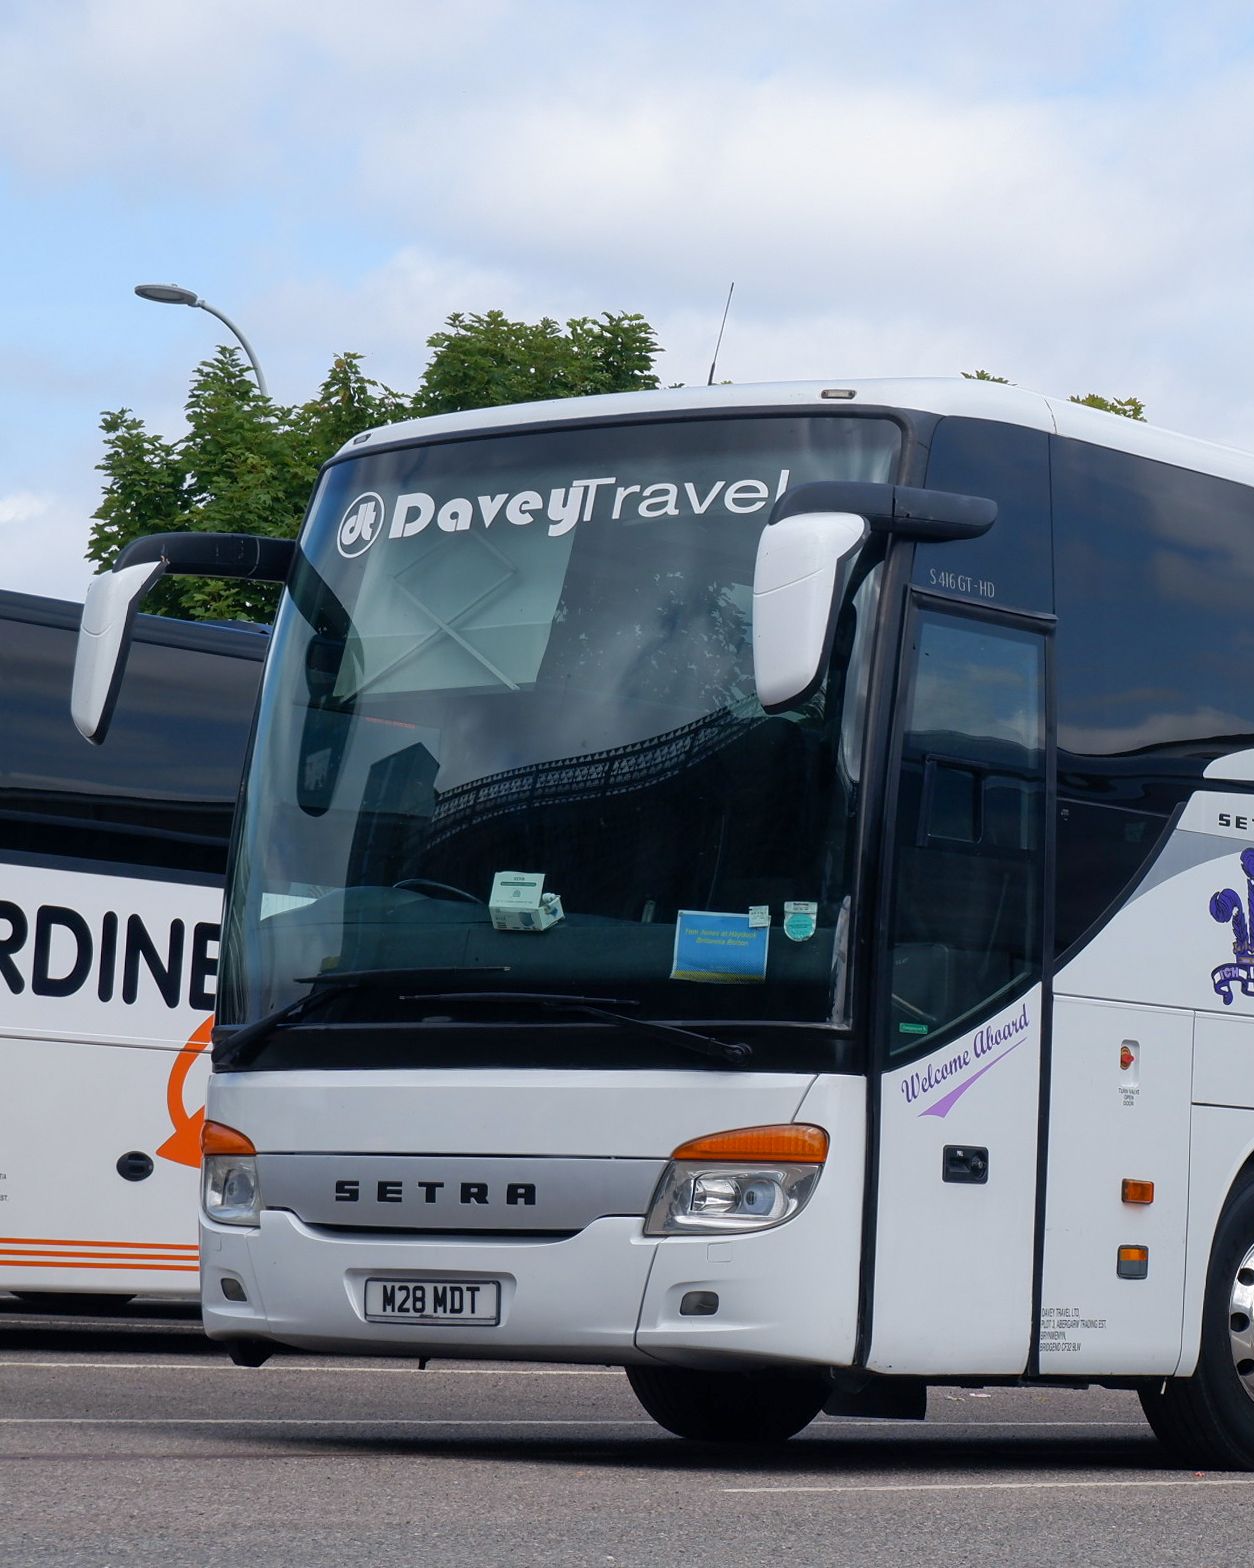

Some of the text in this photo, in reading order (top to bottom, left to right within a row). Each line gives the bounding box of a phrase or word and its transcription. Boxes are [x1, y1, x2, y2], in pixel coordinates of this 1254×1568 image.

[938, 571, 956, 590] 416
[1219, 967, 1240, 980] ICH
[901, 1003, 1030, 1103] Welcome Aboard
[335, 1180, 536, 1206] SETRA
[382, 1284, 480, 1315] M28 MDT
[1042, 1308, 1055, 1317] DAVEY
[1056, 1308, 1071, 1317] TRAVEL
